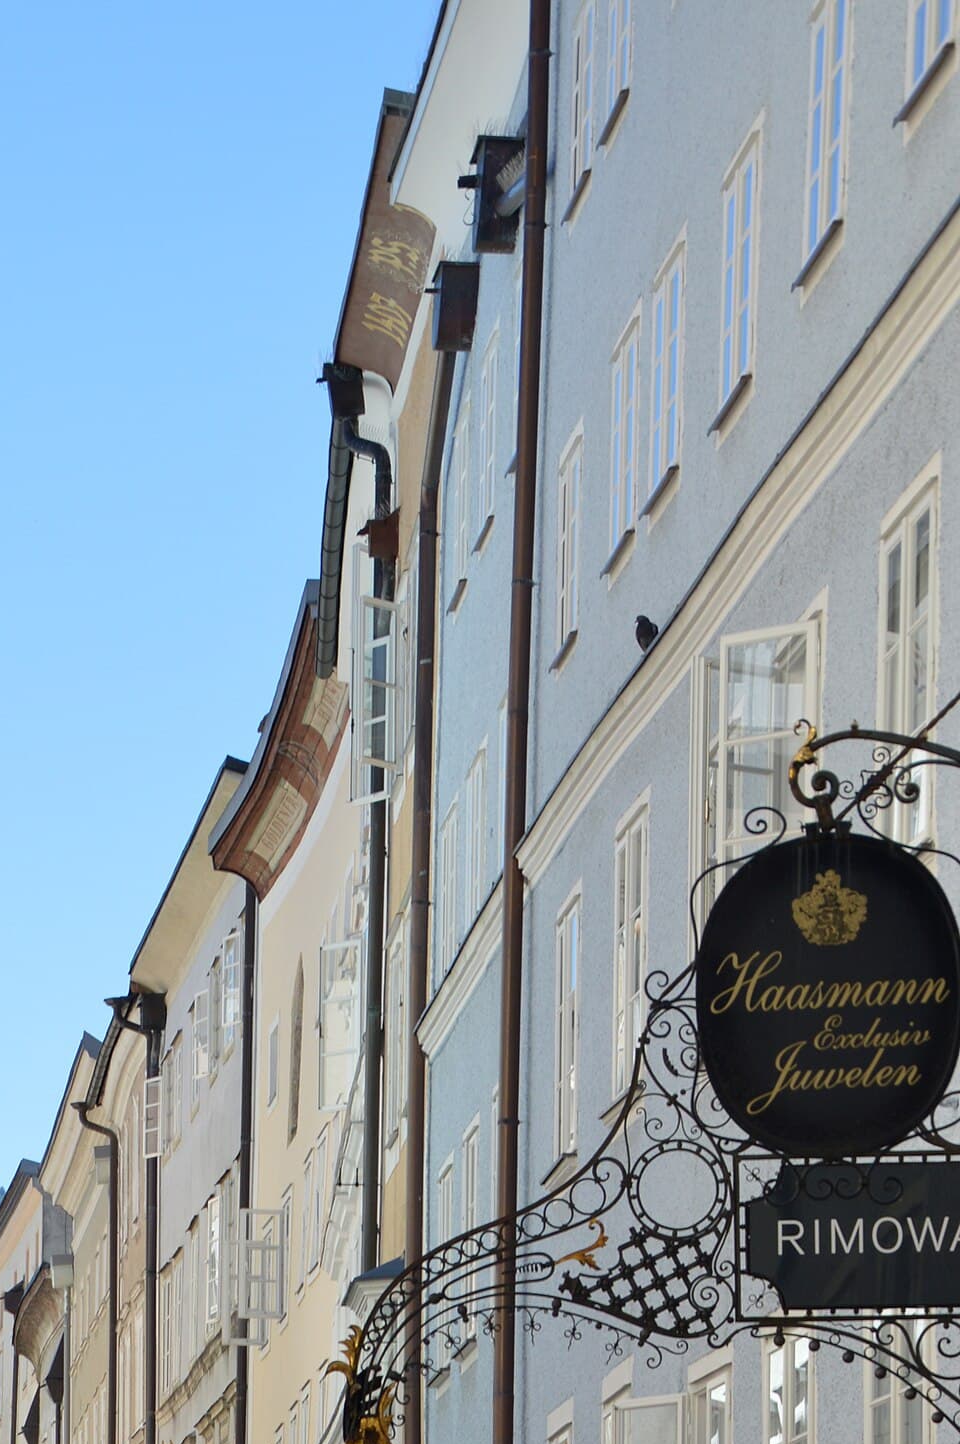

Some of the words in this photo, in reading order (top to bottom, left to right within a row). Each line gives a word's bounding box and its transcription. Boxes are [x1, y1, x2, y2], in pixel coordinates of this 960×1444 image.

[709, 950, 950, 1015] Haasmann
[813, 1013, 931, 1052] Exclusiv
[745, 1041, 922, 1116] Juwelen
